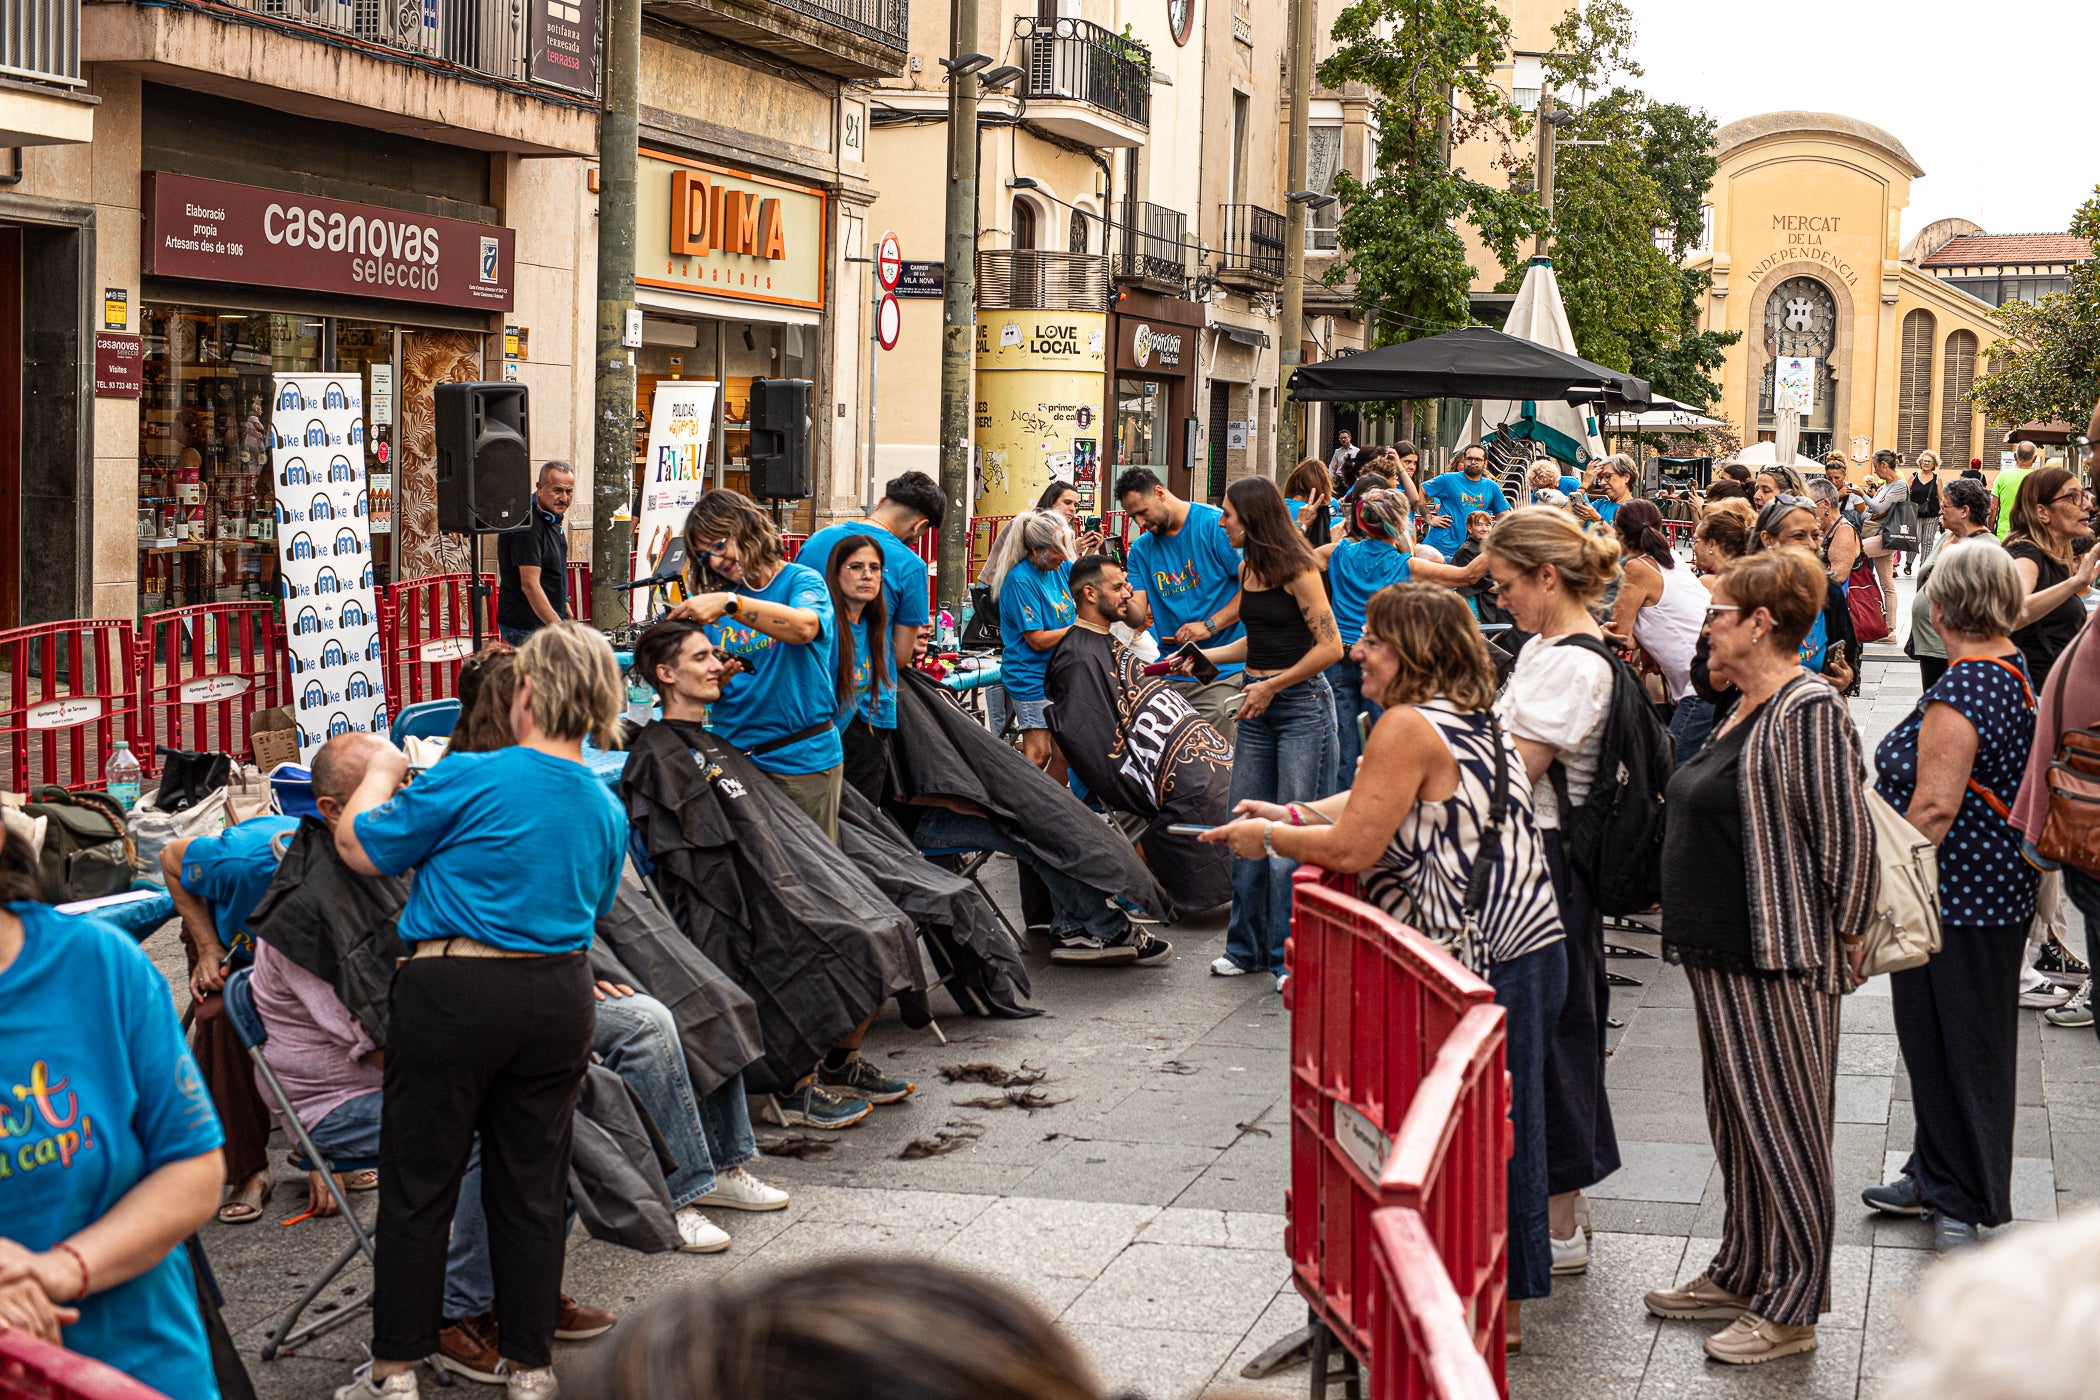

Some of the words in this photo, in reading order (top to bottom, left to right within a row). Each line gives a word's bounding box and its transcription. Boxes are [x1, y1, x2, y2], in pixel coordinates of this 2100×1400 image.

[846, 113, 860, 148] 21
[185, 203, 226, 221] Elaboració
[670, 170, 786, 261] DIMA
[193, 223, 218, 238] propia
[1772, 214, 1841, 232] MERCAT
[165, 234, 199, 251] Artesans
[200, 239, 215, 253] des
[215, 241, 226, 254] de
[227, 242, 244, 257] 1906
[1788, 233, 1805, 245] DE
[1808, 233, 1823, 246] LA
[352, 255, 439, 291] selecció
[1747, 247, 1859, 287] INDEPENDÈNCIA
[903, 276, 918, 284] VILA
[919, 277, 935, 285] NOVA
[1035, 325, 1077, 340] LOVE
[1030, 340, 1081, 355] LOCAL
[109, 365, 128, 374] Visites
[109, 381, 116, 389] 93
[1048, 403, 1077, 413] primer
[1053, 413, 1064, 421] de
[18, 1115, 94, 1169] cap!
